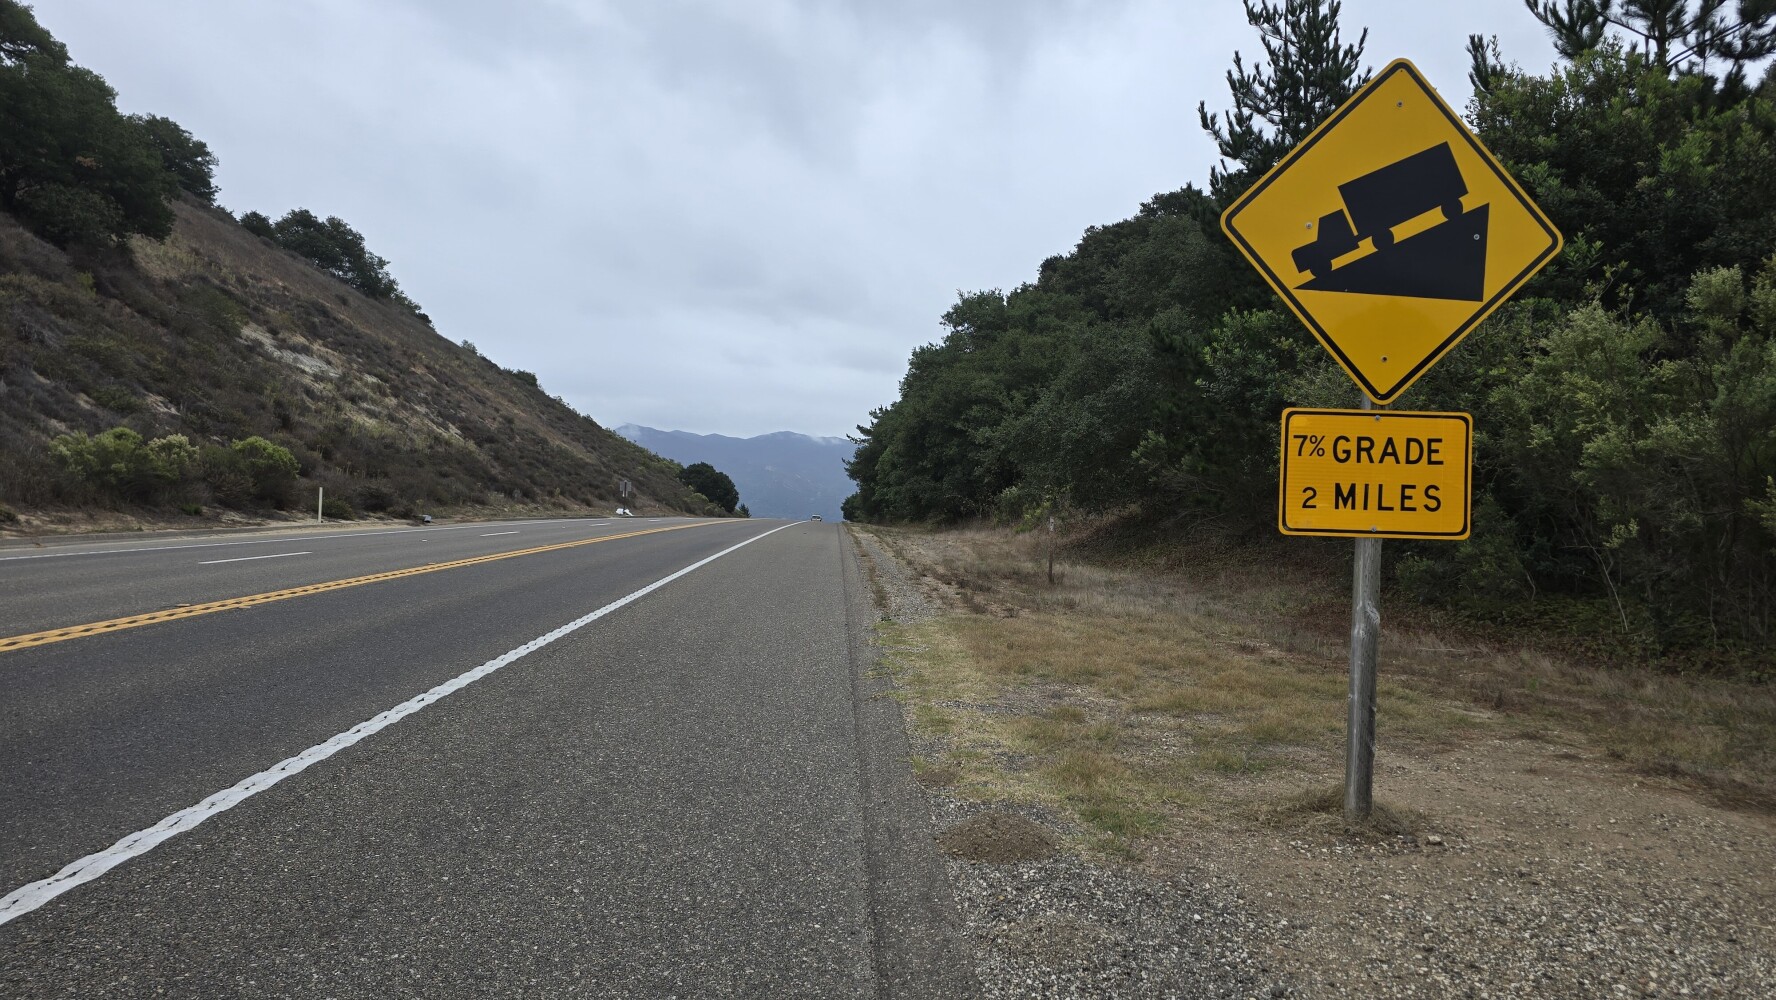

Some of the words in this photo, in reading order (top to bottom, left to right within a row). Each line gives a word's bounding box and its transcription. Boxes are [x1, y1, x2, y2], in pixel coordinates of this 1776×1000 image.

[1293, 435, 1325, 457] 7%
[1332, 435, 1444, 465] GRADE
[1302, 486, 1317, 509] 2
[1334, 483, 1442, 512] MILES
